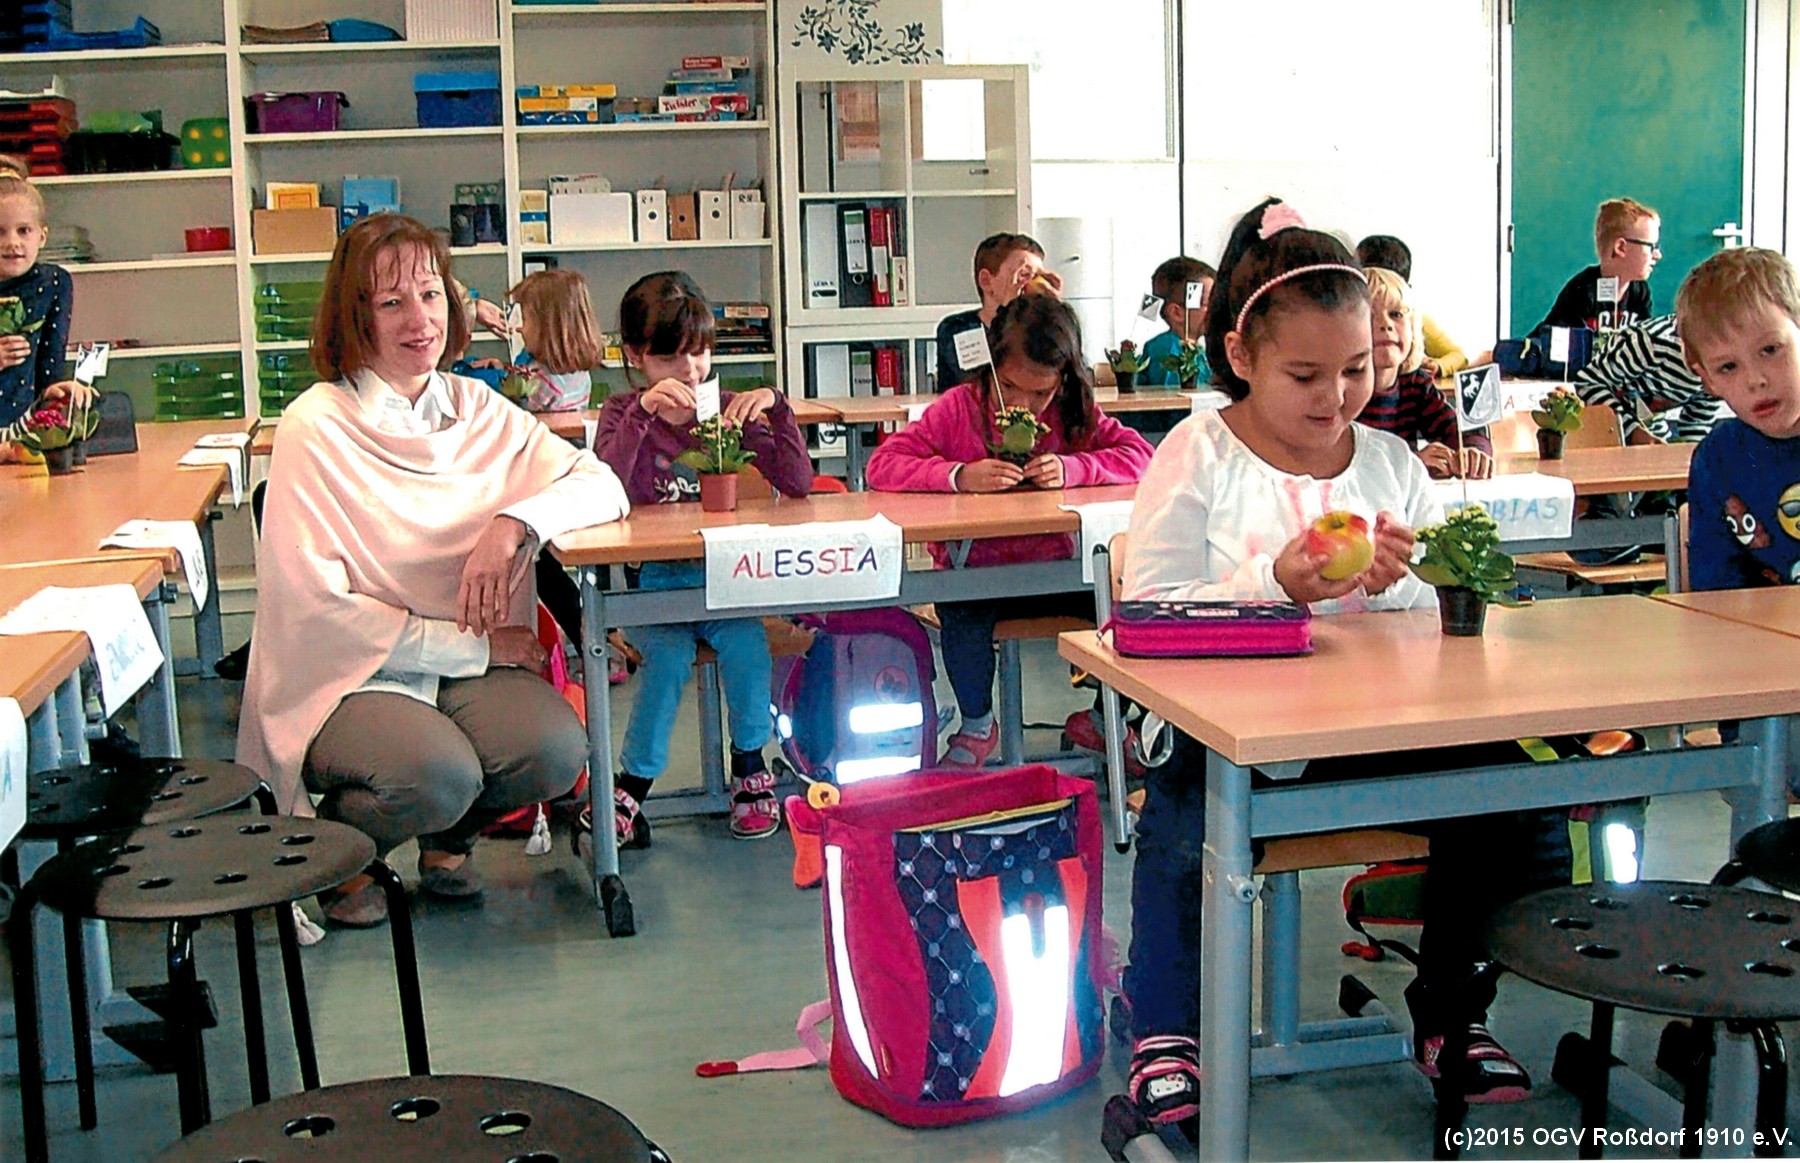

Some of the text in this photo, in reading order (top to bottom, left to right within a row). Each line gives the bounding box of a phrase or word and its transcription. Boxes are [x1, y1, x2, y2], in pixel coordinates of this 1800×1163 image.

[662, 98, 698, 112] Twister
[1452, 497, 1558, 521] BIAS
[732, 546, 878, 579] ALESSIA
